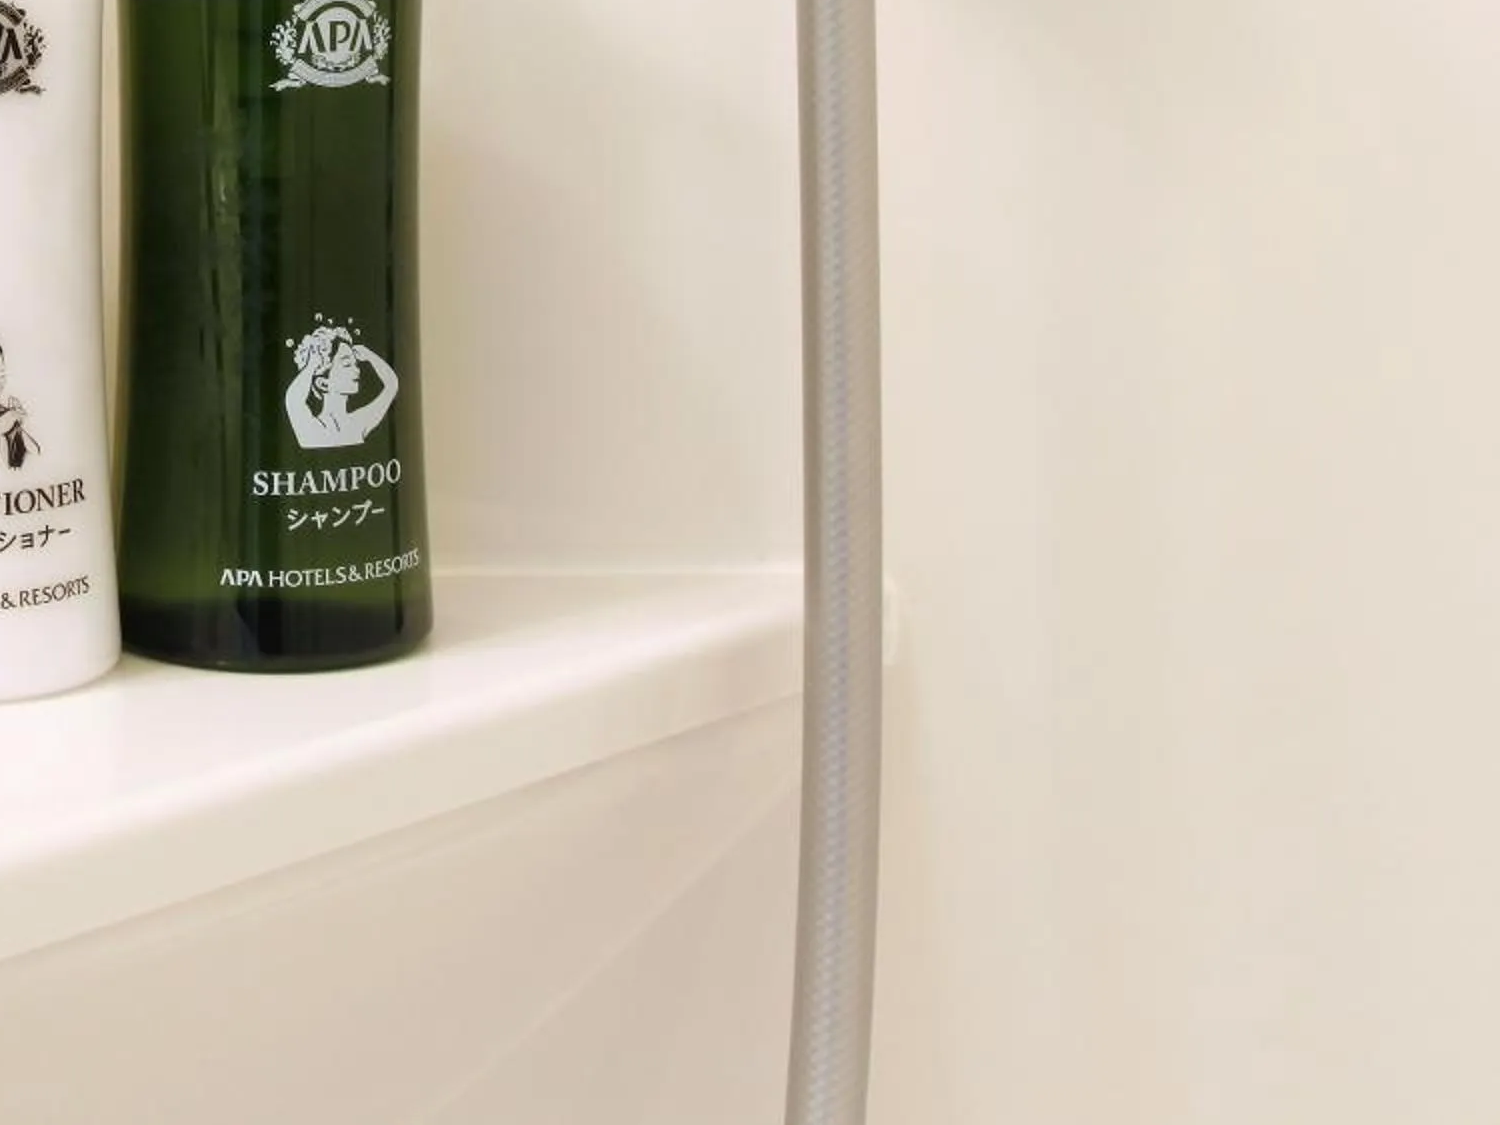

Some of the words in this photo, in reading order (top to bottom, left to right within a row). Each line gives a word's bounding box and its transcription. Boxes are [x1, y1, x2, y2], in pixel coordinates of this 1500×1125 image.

[297, 18, 373, 54] APA
[252, 458, 402, 496] SHAMPOO
[287, 499, 386, 531] シャンプー
[219, 568, 264, 588] APA
